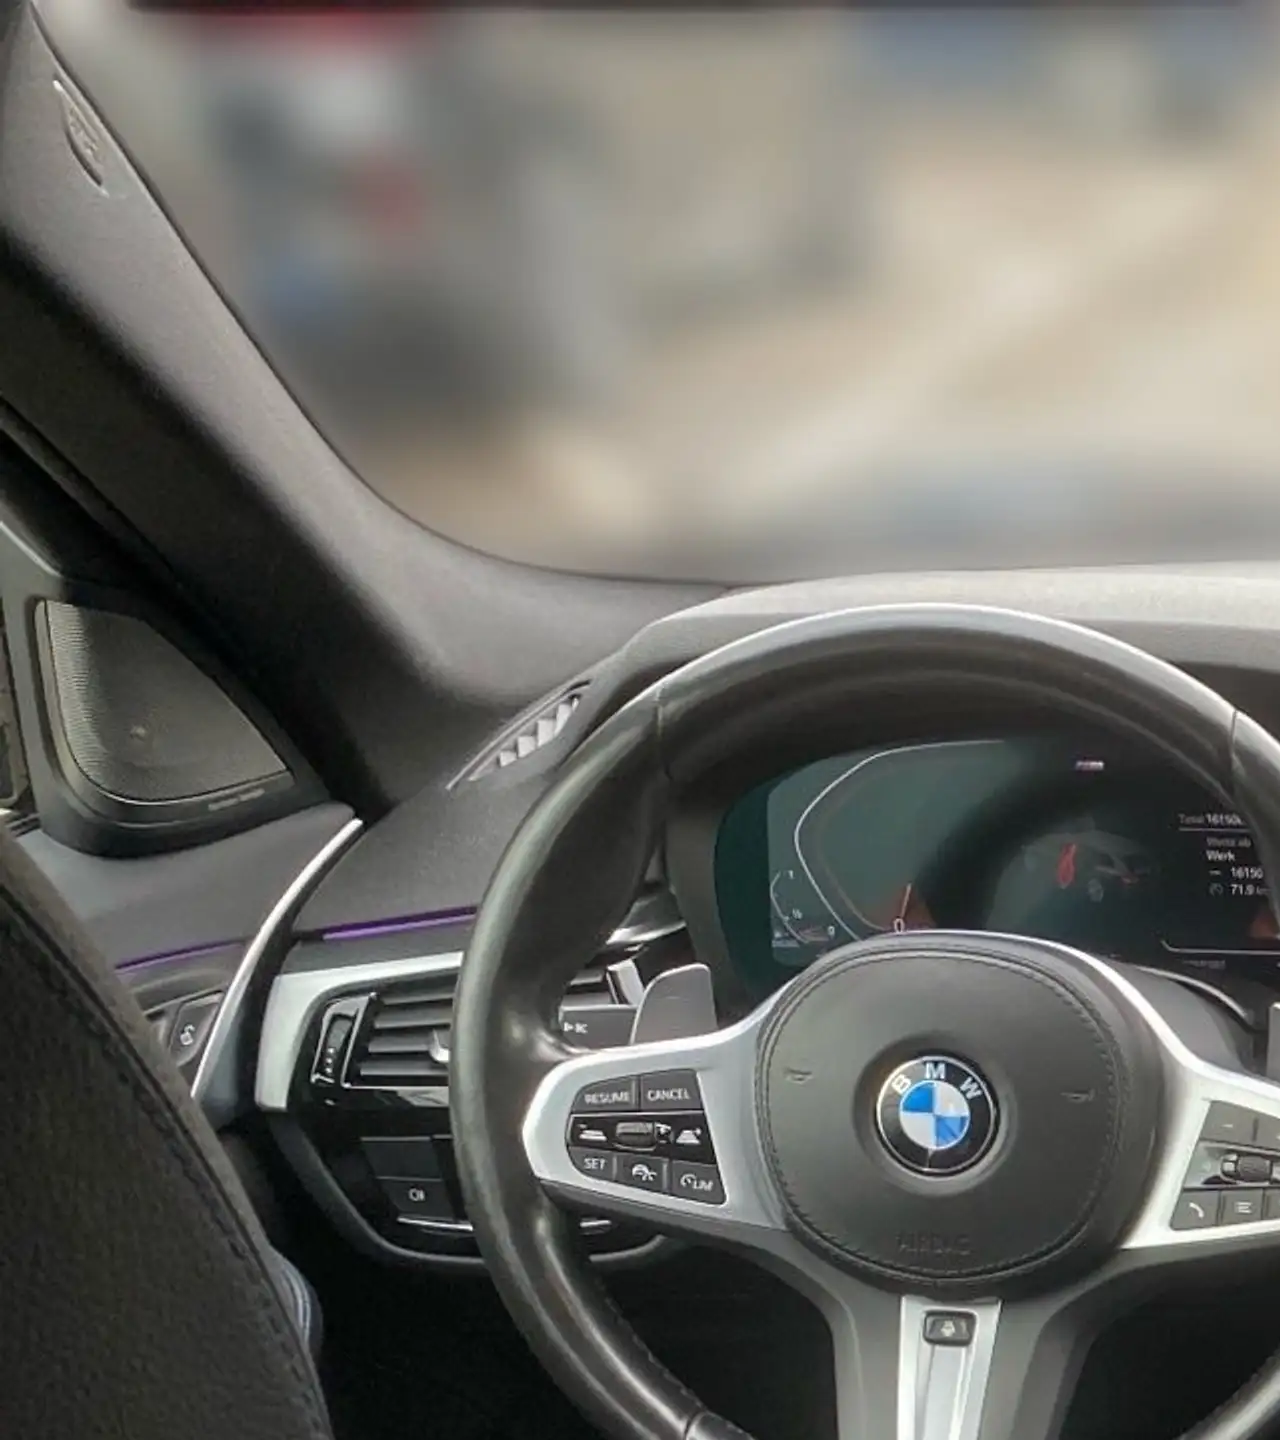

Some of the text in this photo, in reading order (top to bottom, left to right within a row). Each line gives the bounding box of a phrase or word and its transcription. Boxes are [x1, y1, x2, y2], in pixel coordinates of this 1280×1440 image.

[891, 1062, 984, 1101] BMW
[647, 1087, 691, 1102] CANCEL
[583, 1157, 607, 1171] SET
